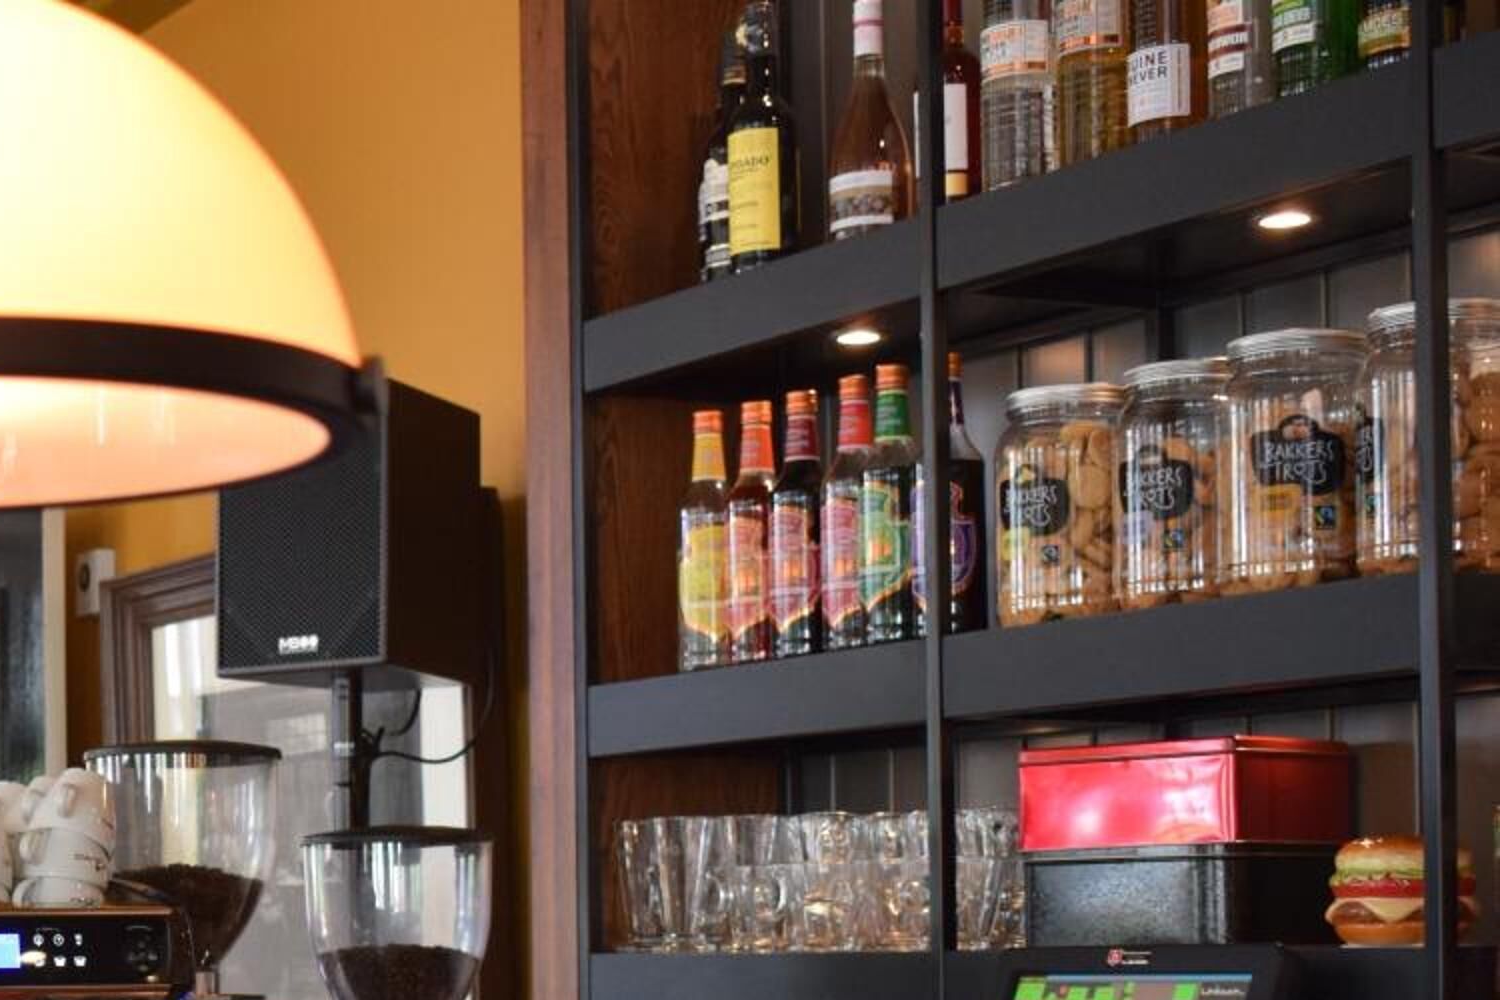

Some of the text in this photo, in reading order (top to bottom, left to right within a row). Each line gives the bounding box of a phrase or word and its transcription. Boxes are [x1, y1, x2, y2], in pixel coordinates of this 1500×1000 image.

[1263, 440, 1335, 464] BAKKERS
[1126, 466, 1183, 488] KKERS
[1004, 484, 1058, 505] KKERS
